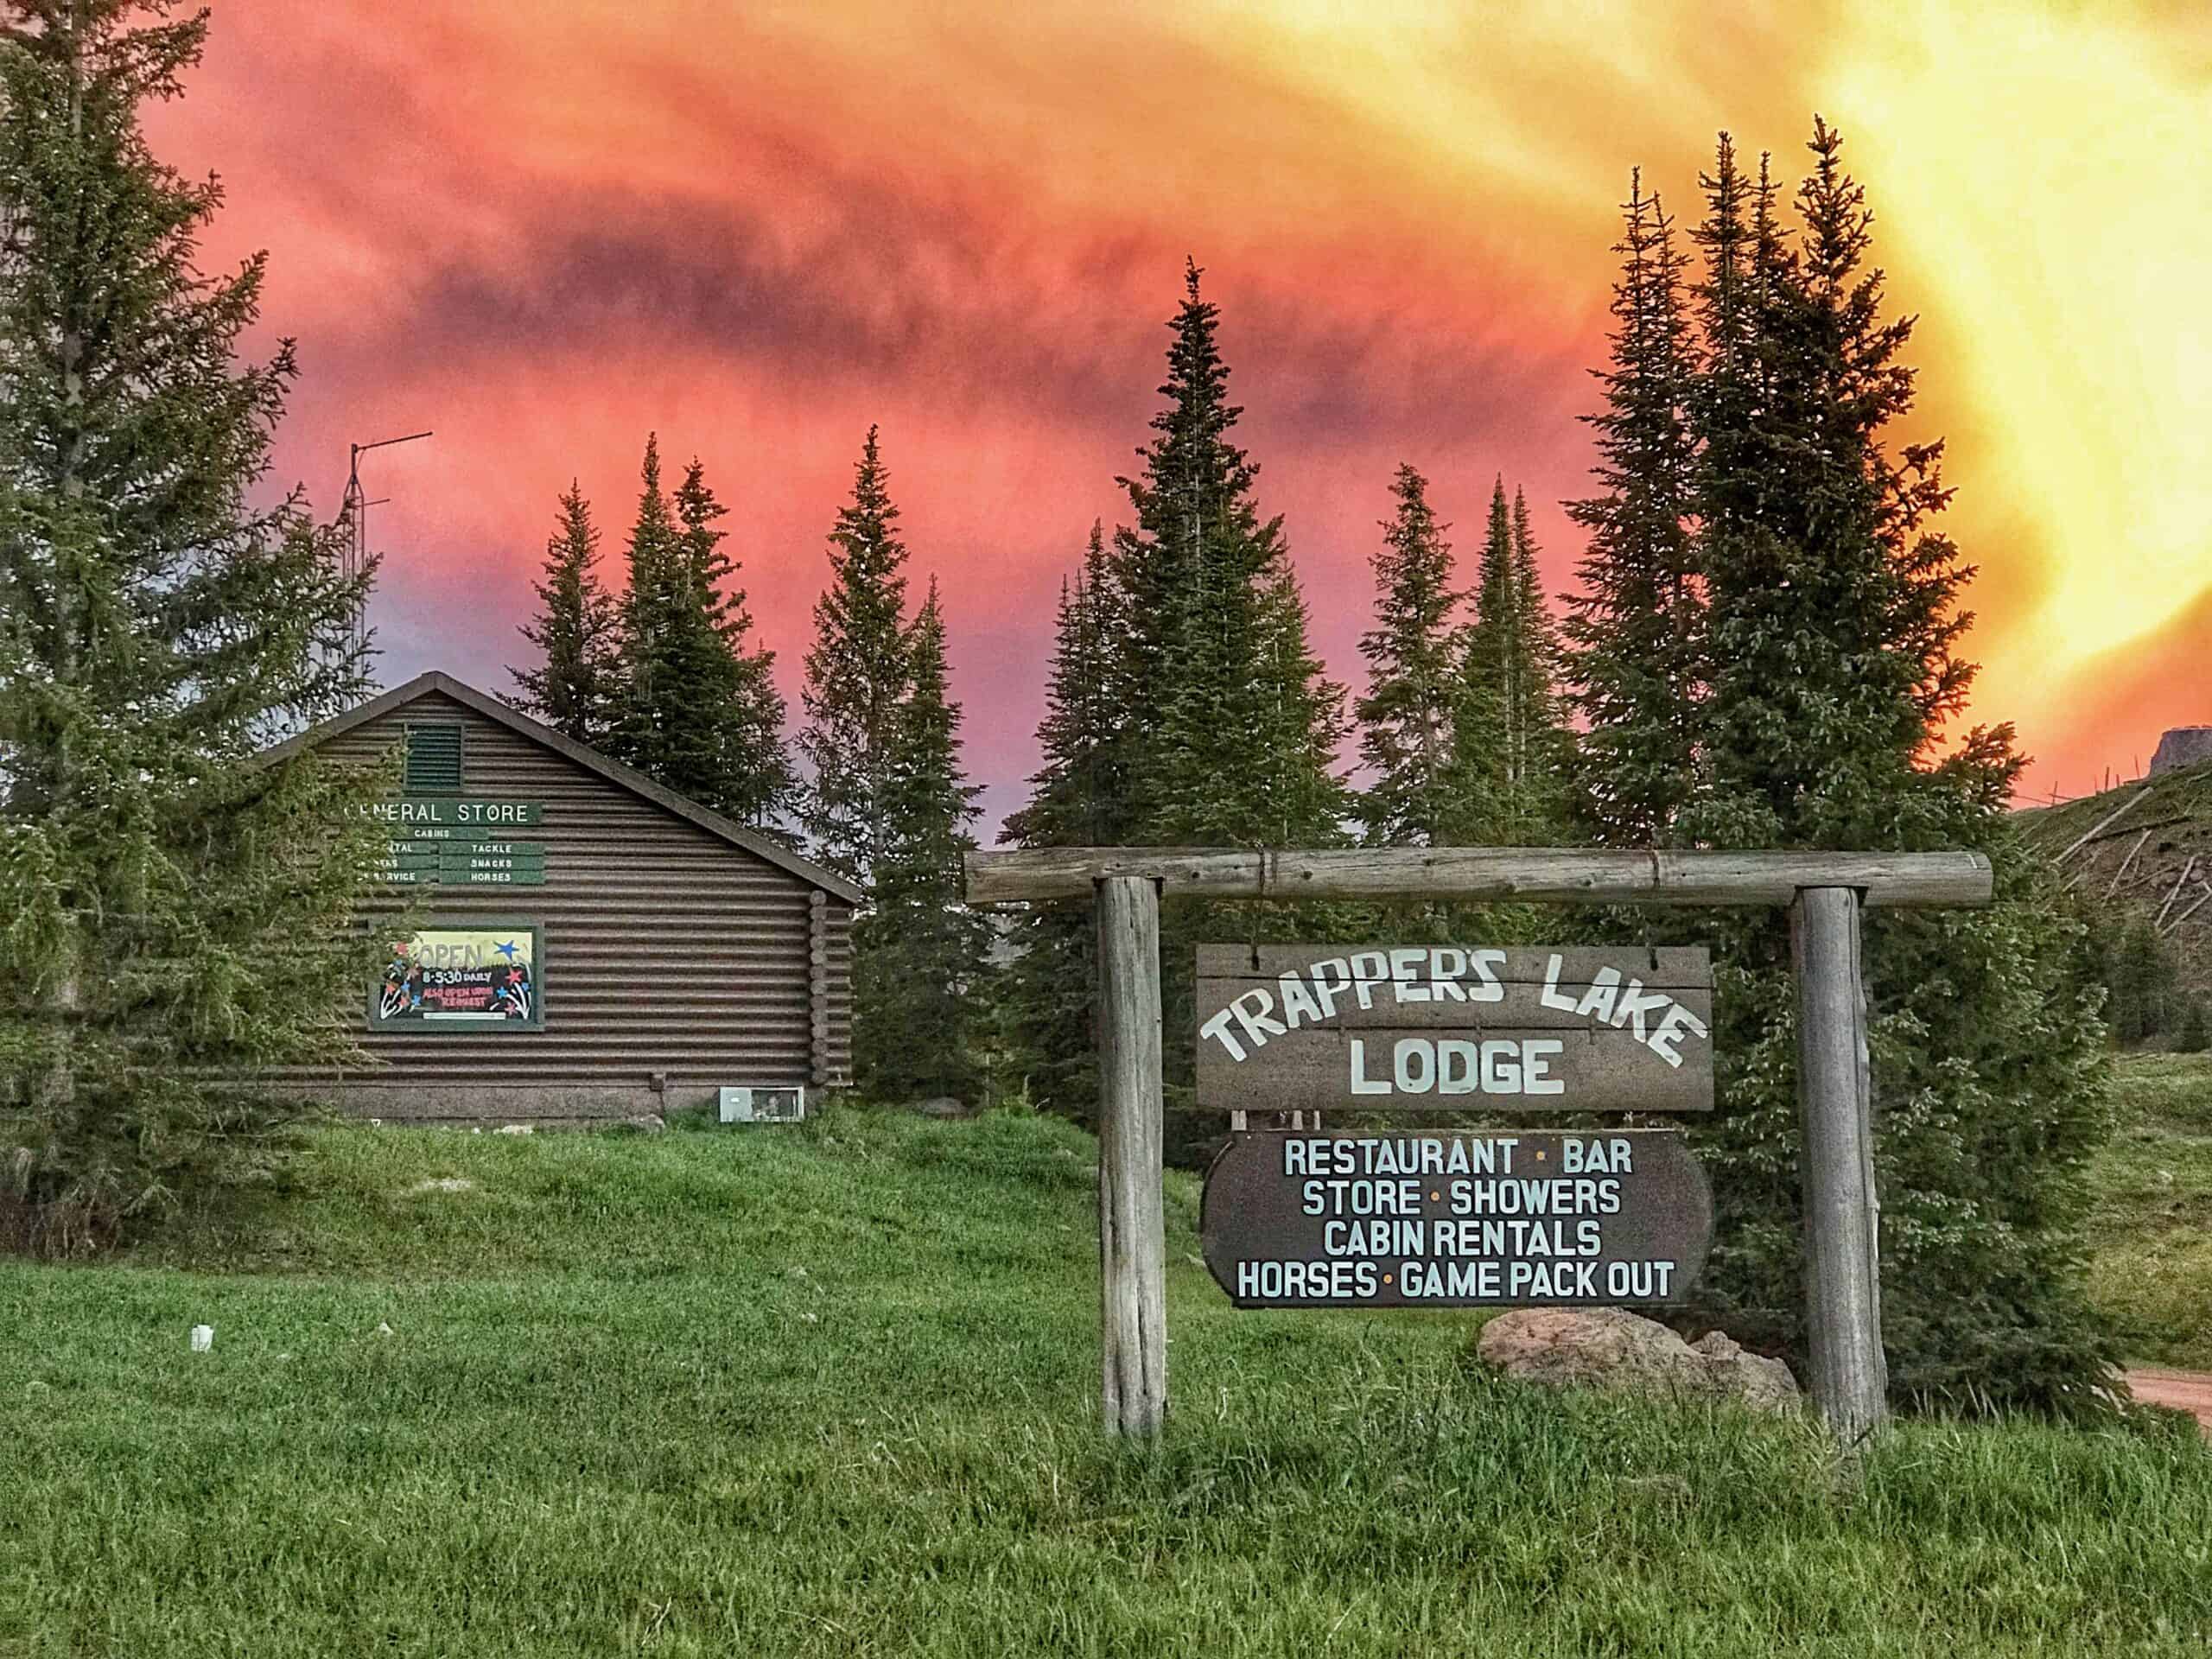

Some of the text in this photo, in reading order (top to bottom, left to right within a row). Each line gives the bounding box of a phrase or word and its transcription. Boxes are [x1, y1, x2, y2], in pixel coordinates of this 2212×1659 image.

[458, 804, 528, 821] STORE
[414, 829, 450, 837] CABINS
[472, 844, 512, 853] TACKLE
[471, 859, 512, 868] SNACKS
[471, 873, 512, 881] HORSES
[419, 944, 484, 968] OPEN
[463, 972, 492, 982] DAILY
[1541, 953, 1708, 1069] LAKE
[1351, 1039, 1565, 1095] LODGE
[1284, 1138, 1633, 1176] RESTAURANT BAR
[1302, 1179, 1621, 1216] STORE SHOWERS
[1324, 1220, 1602, 1256] CABIN RENTALS
[1236, 1261, 1675, 1298] HORSES GAME PACK OUT
